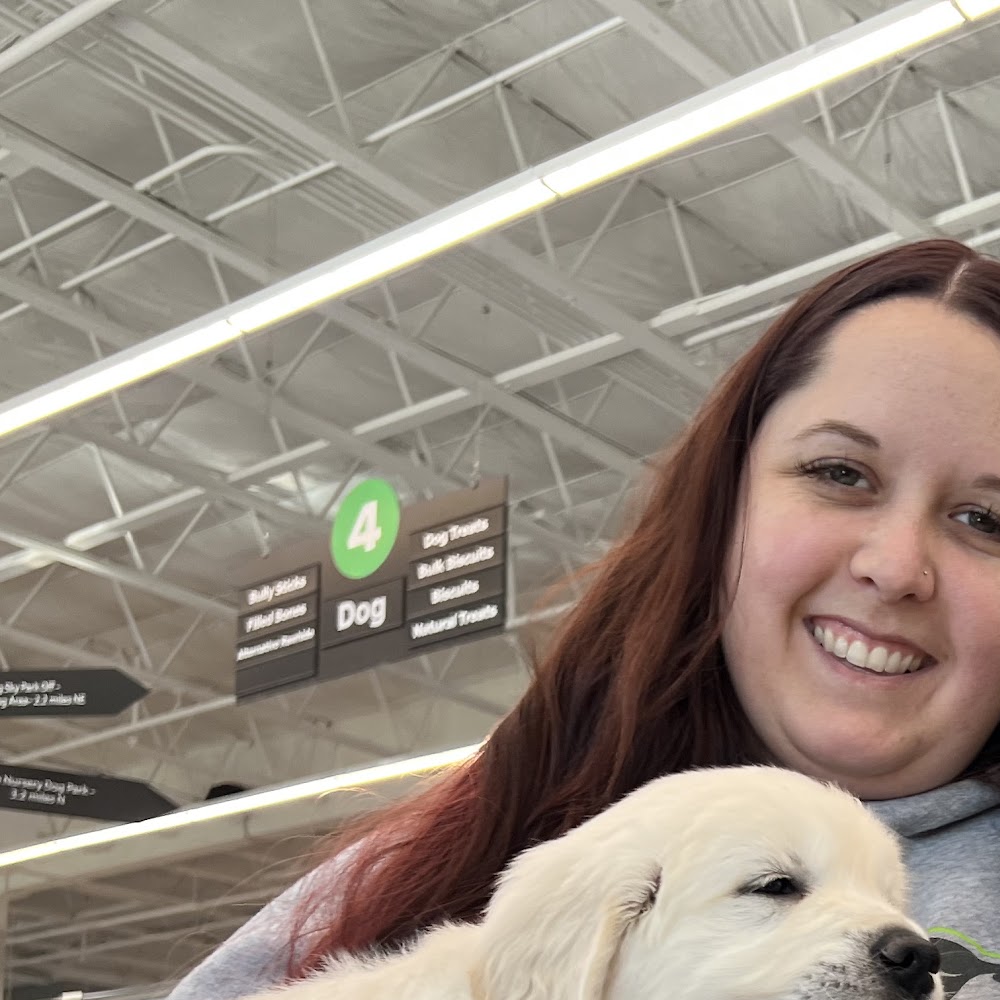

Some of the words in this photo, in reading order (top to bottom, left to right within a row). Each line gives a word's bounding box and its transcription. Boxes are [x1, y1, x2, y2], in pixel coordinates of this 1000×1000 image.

[346, 499, 382, 552] 4
[423, 531, 449, 549] Dog
[448, 518, 489, 541] Treats
[416, 559, 446, 580] Bulk
[445, 546, 495, 571] Biscuits
[247, 584, 275, 606] Bully
[274, 575, 307, 597] Sticks
[430, 580, 480, 605] Biscuits
[246, 610, 275, 633] Filled
[274, 603, 308, 624] Bones
[336, 595, 387, 632] Dog
[411, 612, 458, 639] Natural
[458, 604, 498, 627] Treats
